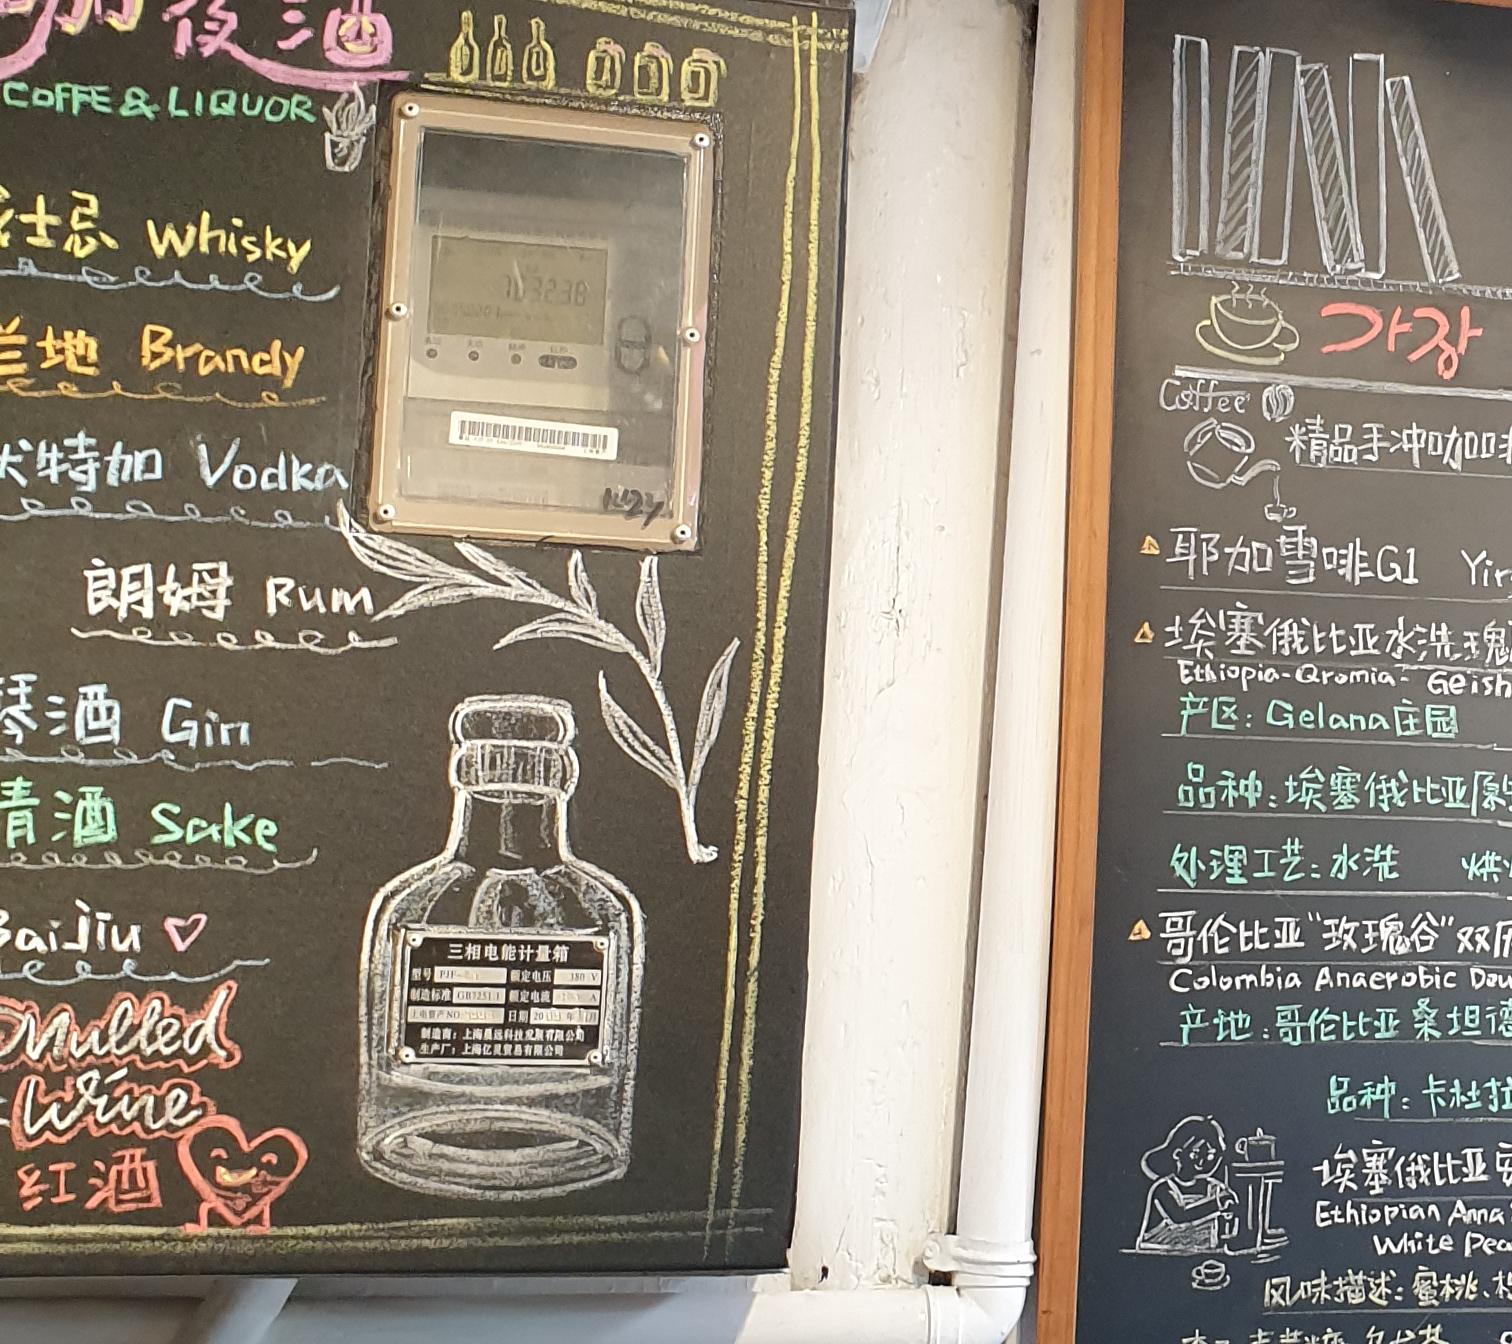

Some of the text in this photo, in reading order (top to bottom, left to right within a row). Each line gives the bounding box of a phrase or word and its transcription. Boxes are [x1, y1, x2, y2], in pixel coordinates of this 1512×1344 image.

[119, 86, 160, 121] &
[169, 86, 317, 124] LIQUOR
[146, 210, 311, 274] Whisky
[141, 324, 305, 389] Brandy
[1320, 302, 1484, 379] 가장
[197, 433, 350, 491] Vodka
[83, 558, 374, 622] 朗姆 Rum
[161, 698, 251, 749] Gin
[150, 801, 278, 853] Sake
[448, 942, 570, 963] 三相电能计量箱
[1168, 964, 1302, 992] Colombia
[1314, 965, 1457, 992] Anaerobic
[23, 1067, 202, 1136] Wine
[16, 1147, 163, 1213] 红酒
[1314, 1199, 1441, 1234] Ethiopian
[1447, 1199, 1504, 1226] Anna
[1372, 1232, 1455, 1256] White
